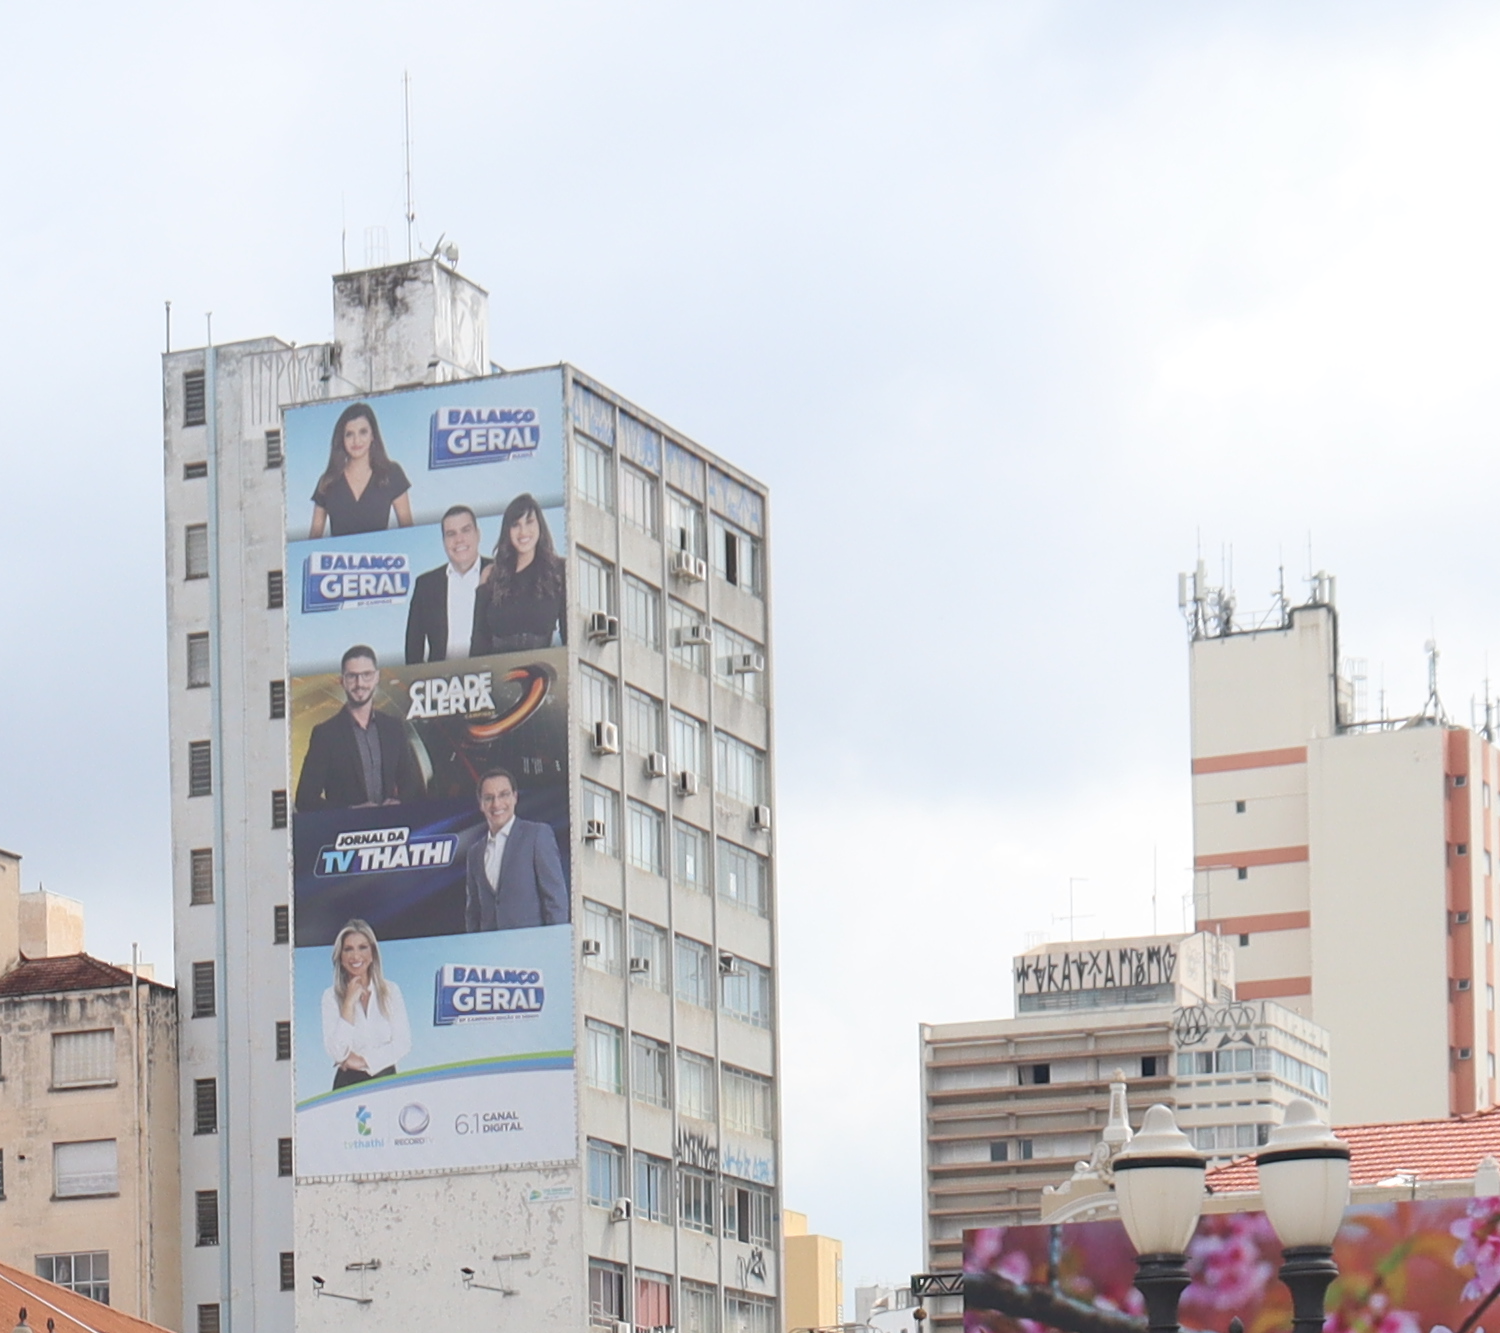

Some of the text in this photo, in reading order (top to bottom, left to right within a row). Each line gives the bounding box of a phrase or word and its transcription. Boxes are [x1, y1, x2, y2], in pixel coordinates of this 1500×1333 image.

[448, 408, 536, 425] BALANÇO
[447, 426, 537, 455] GERAL
[320, 554, 406, 571] BALANÇO
[320, 573, 407, 599] GERAL
[409, 671, 492, 701] CIDADE
[406, 689, 495, 720] ALERTA
[338, 830, 405, 846] JORNAL DA
[322, 840, 452, 873] TV THATHI
[453, 966, 540, 985] BALANÇO
[452, 986, 541, 1013] GERAL
[455, 1110, 519, 1135] 6.1 CANAL
[482, 1121, 523, 1133] DIGITAL
